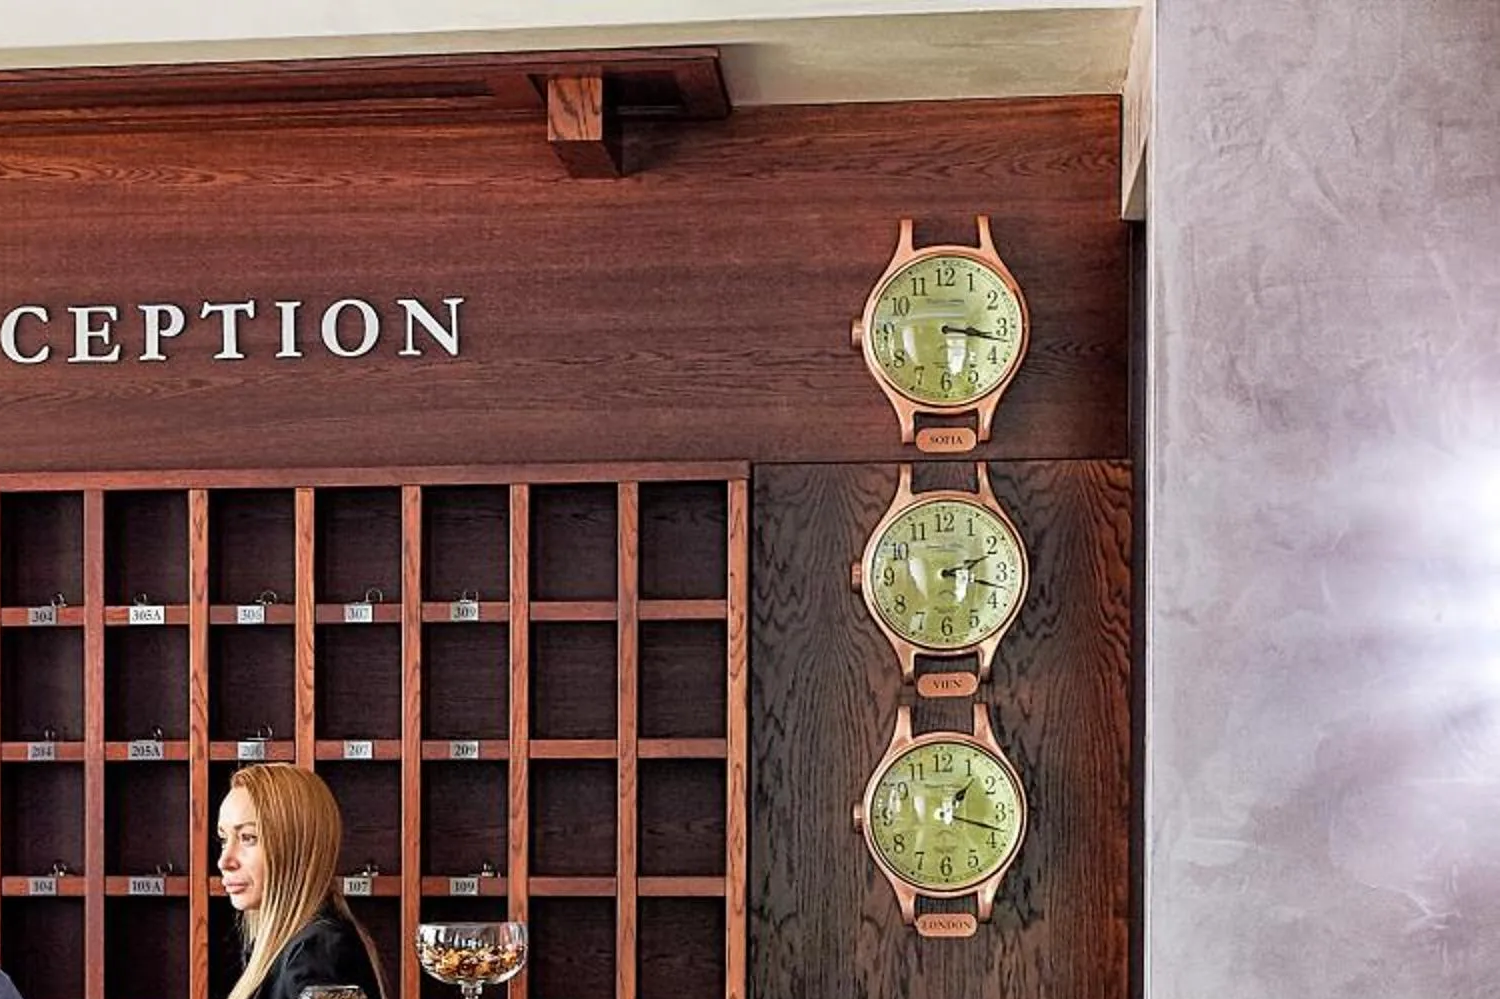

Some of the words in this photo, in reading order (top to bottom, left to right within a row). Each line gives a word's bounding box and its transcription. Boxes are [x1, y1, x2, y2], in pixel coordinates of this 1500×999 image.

[911, 277, 929, 297] 11
[935, 267, 956, 287] 12
[967, 272, 976, 292] 1
[892, 296, 911, 317] 10
[986, 290, 999, 310] 2
[996, 317, 1008, 337] 3
[893, 350, 905, 368] 8
[987, 346, 998, 365] 4
[914, 365, 925, 385] 7
[940, 371, 953, 392] 6
[967, 363, 979, 384] 5
[930, 435, 963, 445] SOFIA
[910, 522, 927, 542] 11
[935, 512, 955, 533] 12
[966, 517, 976, 537] 1
[892, 541, 909, 561] 10
[985, 535, 998, 555] 2
[883, 567, 895, 587] 9
[996, 561, 1008, 581] 3
[893, 594, 907, 614] 8
[987, 591, 998, 609] 4
[31, 611, 53, 623] 304
[915, 611, 926, 631] 7
[940, 616, 953, 637] 6
[969, 608, 980, 629] 5
[131, 745, 161, 757] 205A
[908, 763, 925, 781] 11
[932, 752, 953, 773] 12
[966, 759, 974, 777] 1
[889, 781, 909, 801] 0
[985, 775, 997, 795] 2
[995, 802, 1007, 822] 3
[892, 833, 905, 854] 8
[985, 831, 997, 849] 4
[914, 851, 925, 871] 7
[939, 856, 953, 877] 6
[967, 849, 979, 869] 5
[33, 881, 53, 893] 104
[348, 881, 368, 893] 107
